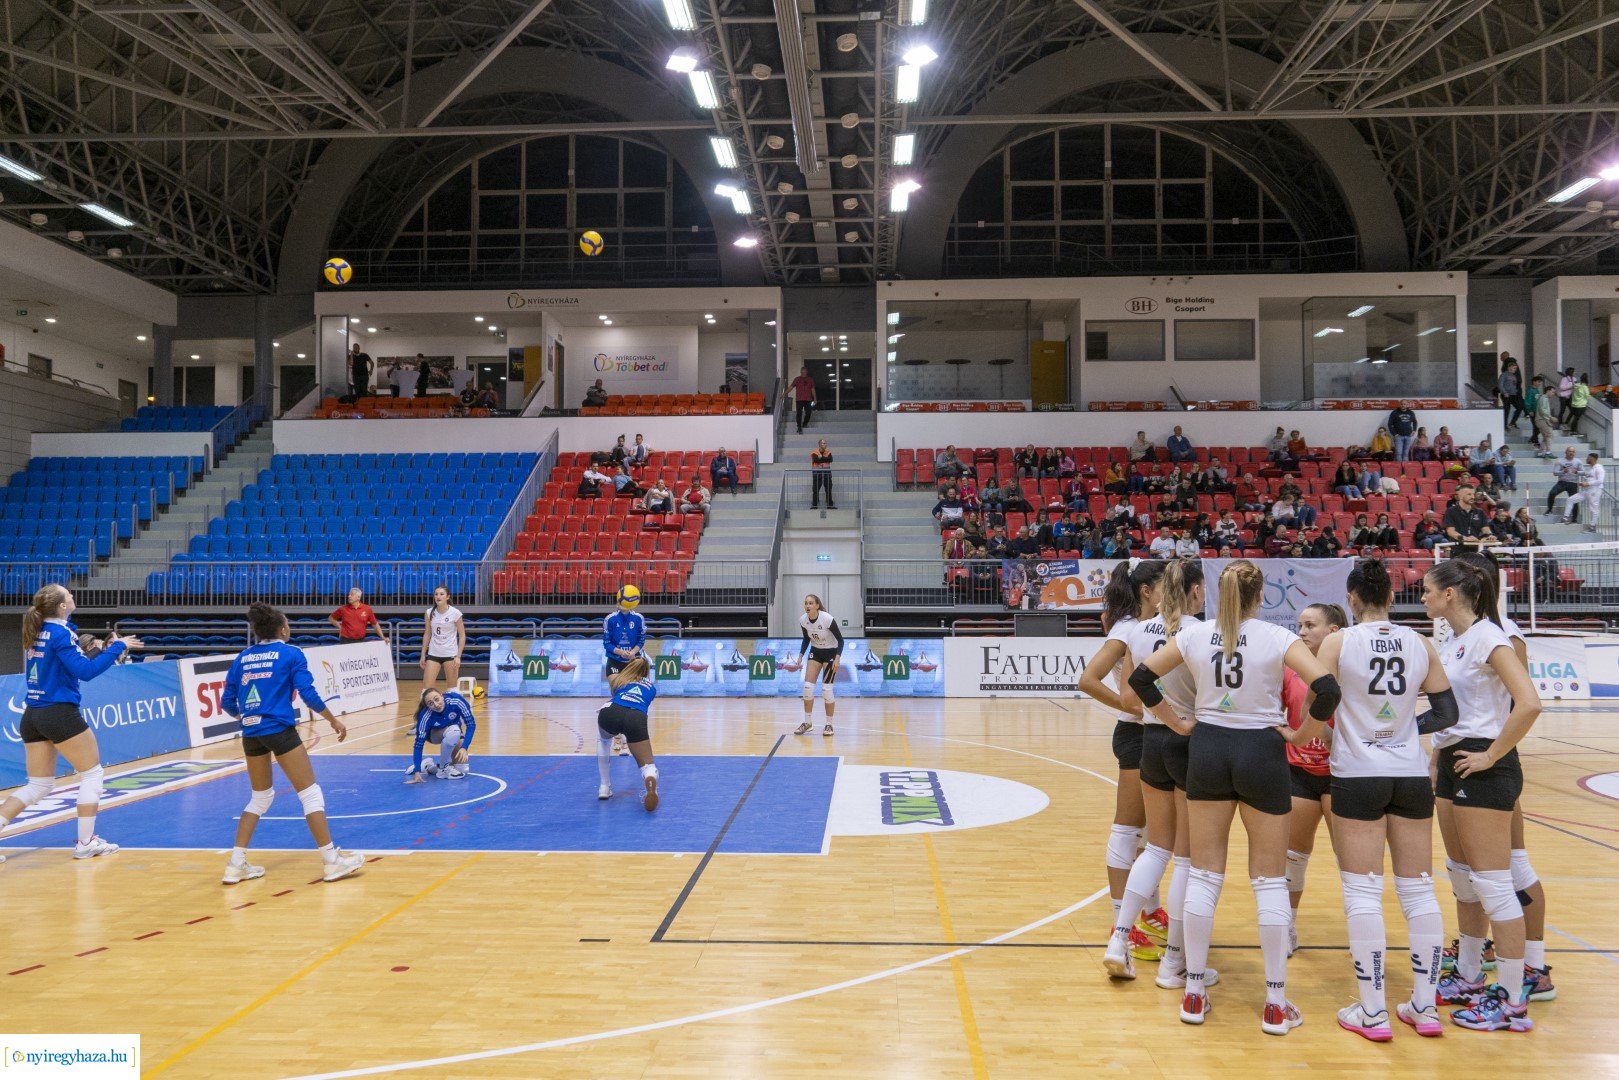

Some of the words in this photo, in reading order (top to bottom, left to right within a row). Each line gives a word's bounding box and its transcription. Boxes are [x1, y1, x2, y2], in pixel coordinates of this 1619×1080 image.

[527, 297, 579, 305] NYÍREGYHÁZA
[1131, 300, 1152, 311] BH
[1174, 305, 1205, 313] Csoport
[616, 361, 650, 372] Többet
[1370, 638, 1403, 653] LEBAN
[340, 656, 380, 673] NYÍREGYHÁZI
[980, 644, 1087, 675] FATUM
[1210, 651, 1244, 689] 13
[1367, 656, 1407, 696] 23
[342, 672, 391, 690] SPORTCENTRUM
[981, 675, 1082, 683] PROPERT
